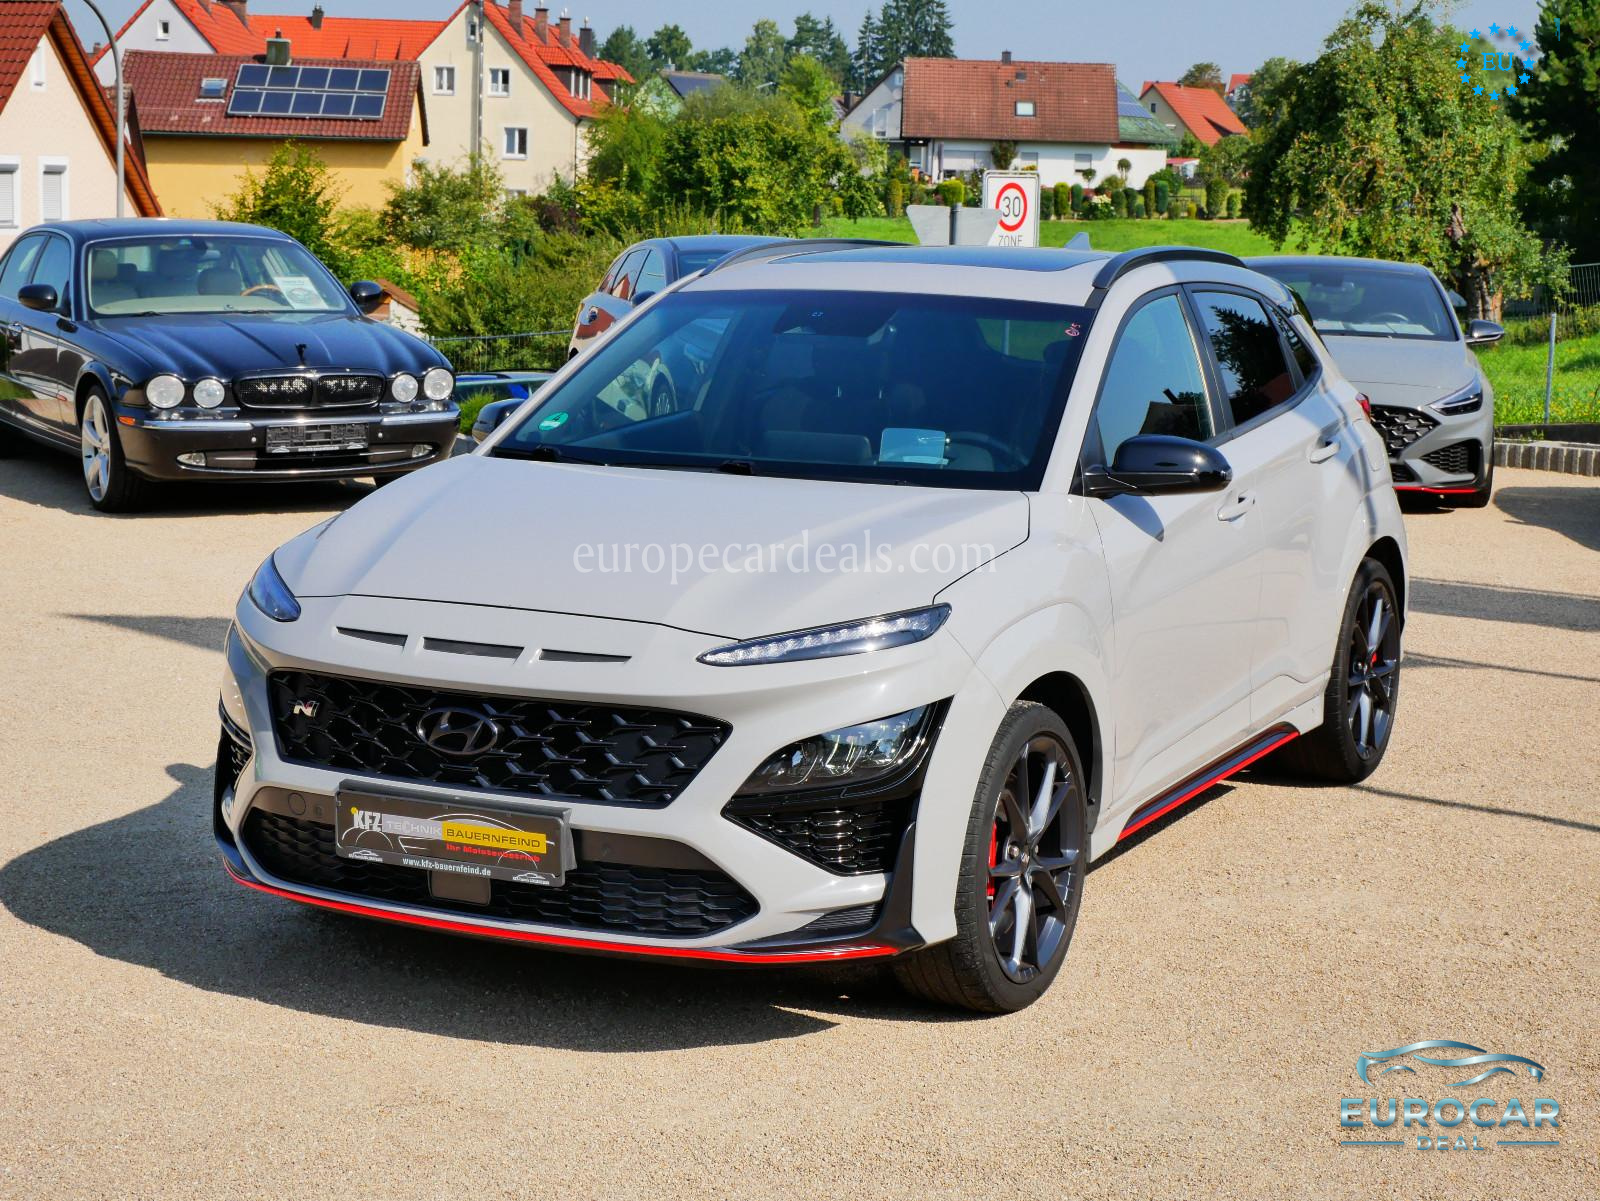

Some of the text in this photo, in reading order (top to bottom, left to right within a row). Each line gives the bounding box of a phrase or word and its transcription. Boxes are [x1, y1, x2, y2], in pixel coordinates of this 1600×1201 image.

[1002, 196, 1021, 218] 30
[446, 828, 541, 848] BAUERNFEIND
[402, 858, 492, 876] www.kfz-bauernfeind.de
